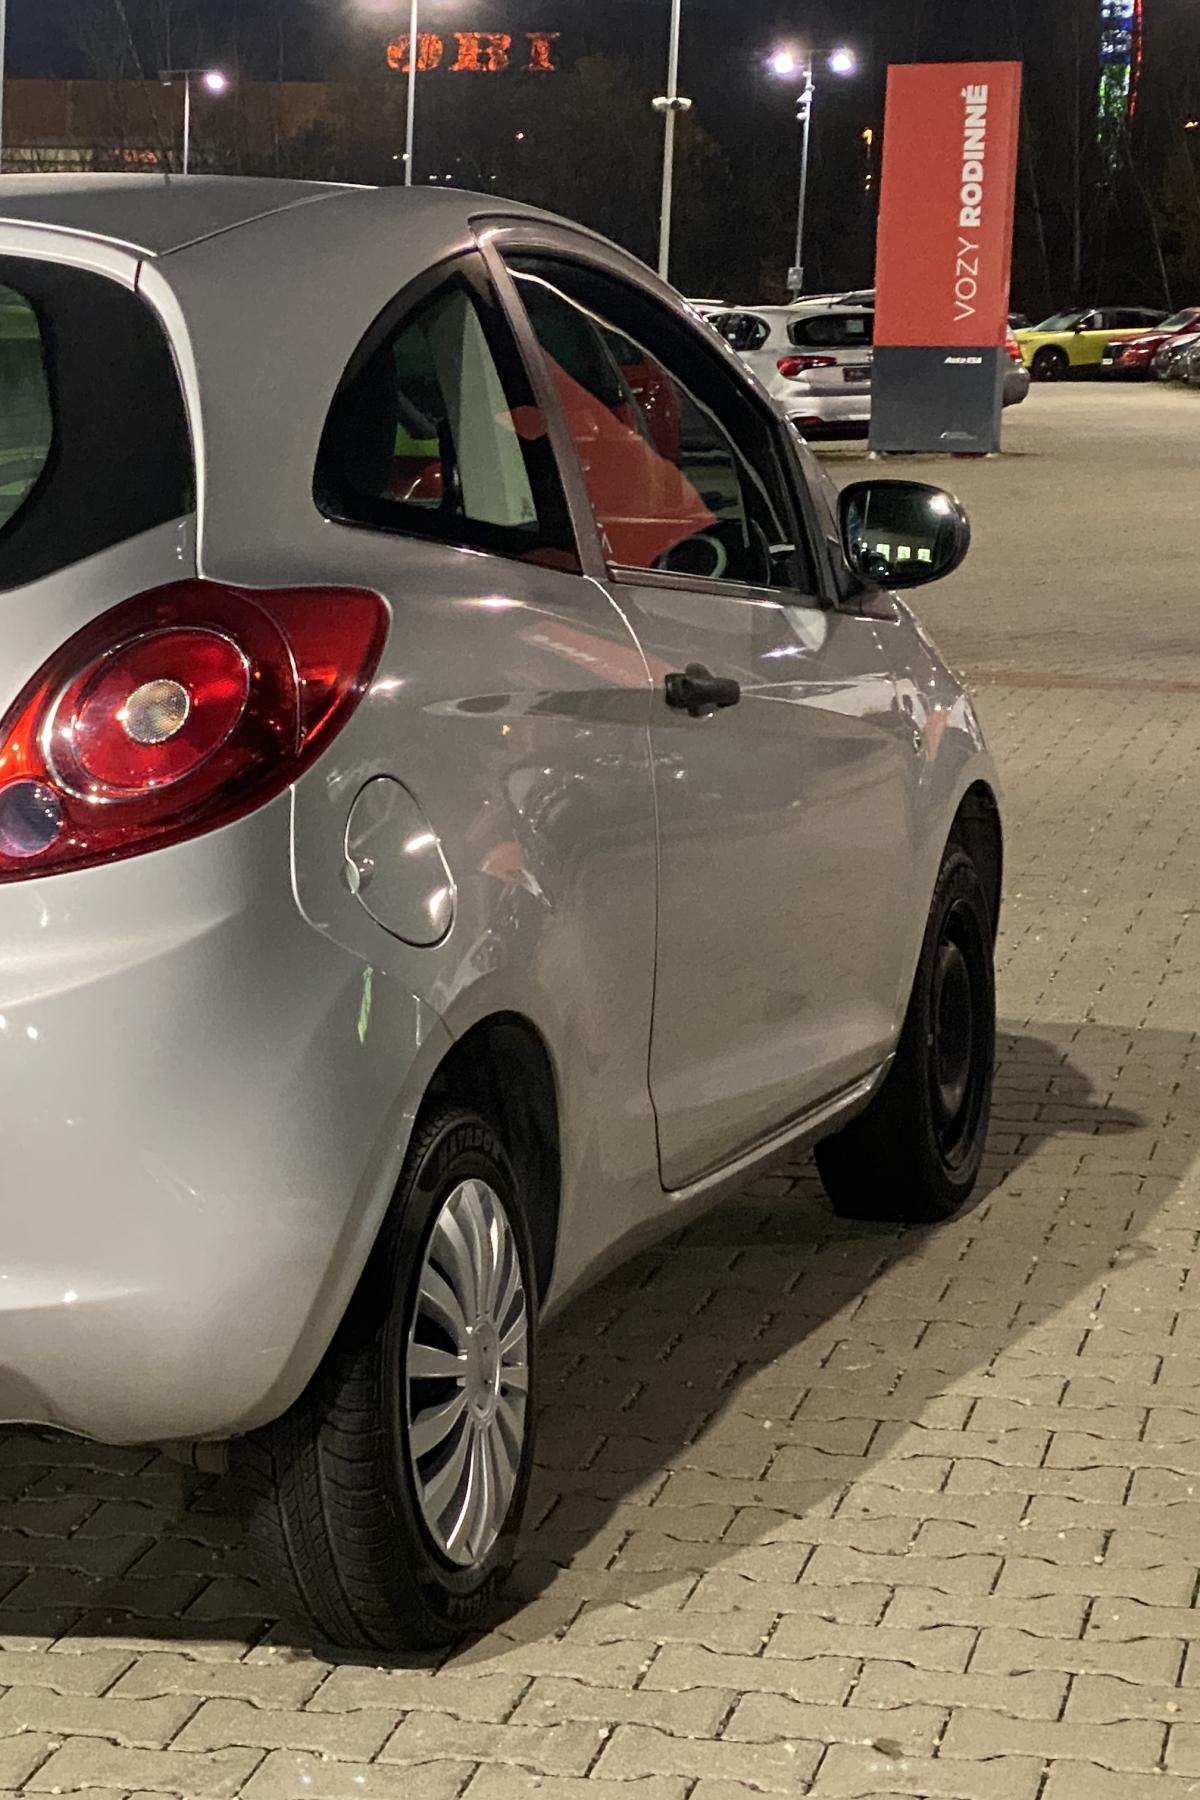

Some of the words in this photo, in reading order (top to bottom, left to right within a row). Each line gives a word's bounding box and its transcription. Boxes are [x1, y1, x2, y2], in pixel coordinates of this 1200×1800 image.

[386, 32, 560, 71] OBI
[959, 84, 989, 227] RODINNÉ
[953, 237, 980, 321] VOZY
